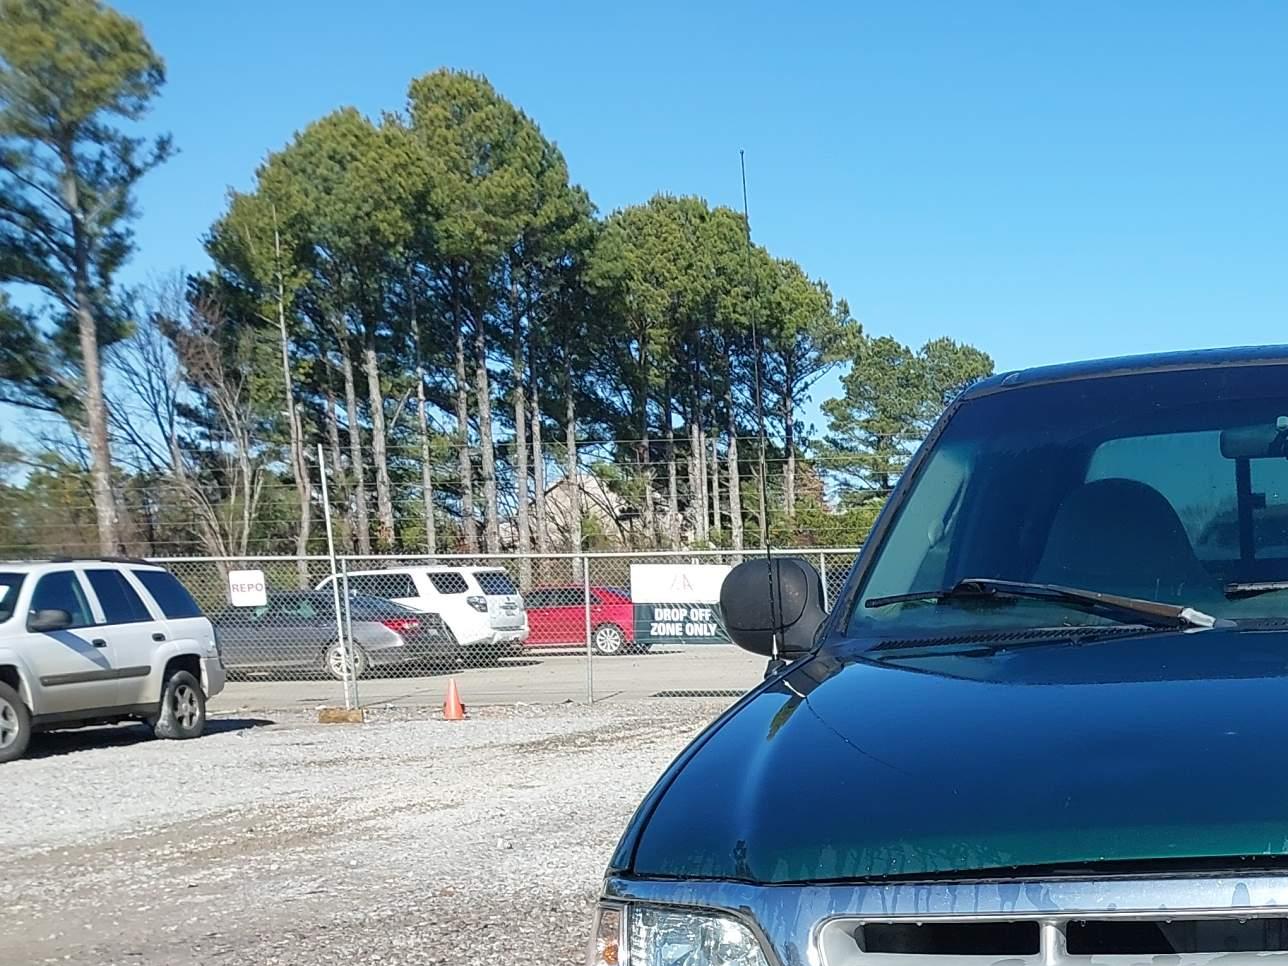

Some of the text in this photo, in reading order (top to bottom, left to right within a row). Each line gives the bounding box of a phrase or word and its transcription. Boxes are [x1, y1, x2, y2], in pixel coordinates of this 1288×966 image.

[231, 583, 264, 592] REPO
[654, 608, 712, 621] DROP OFF
[650, 623, 717, 636] ZONE ONLY
